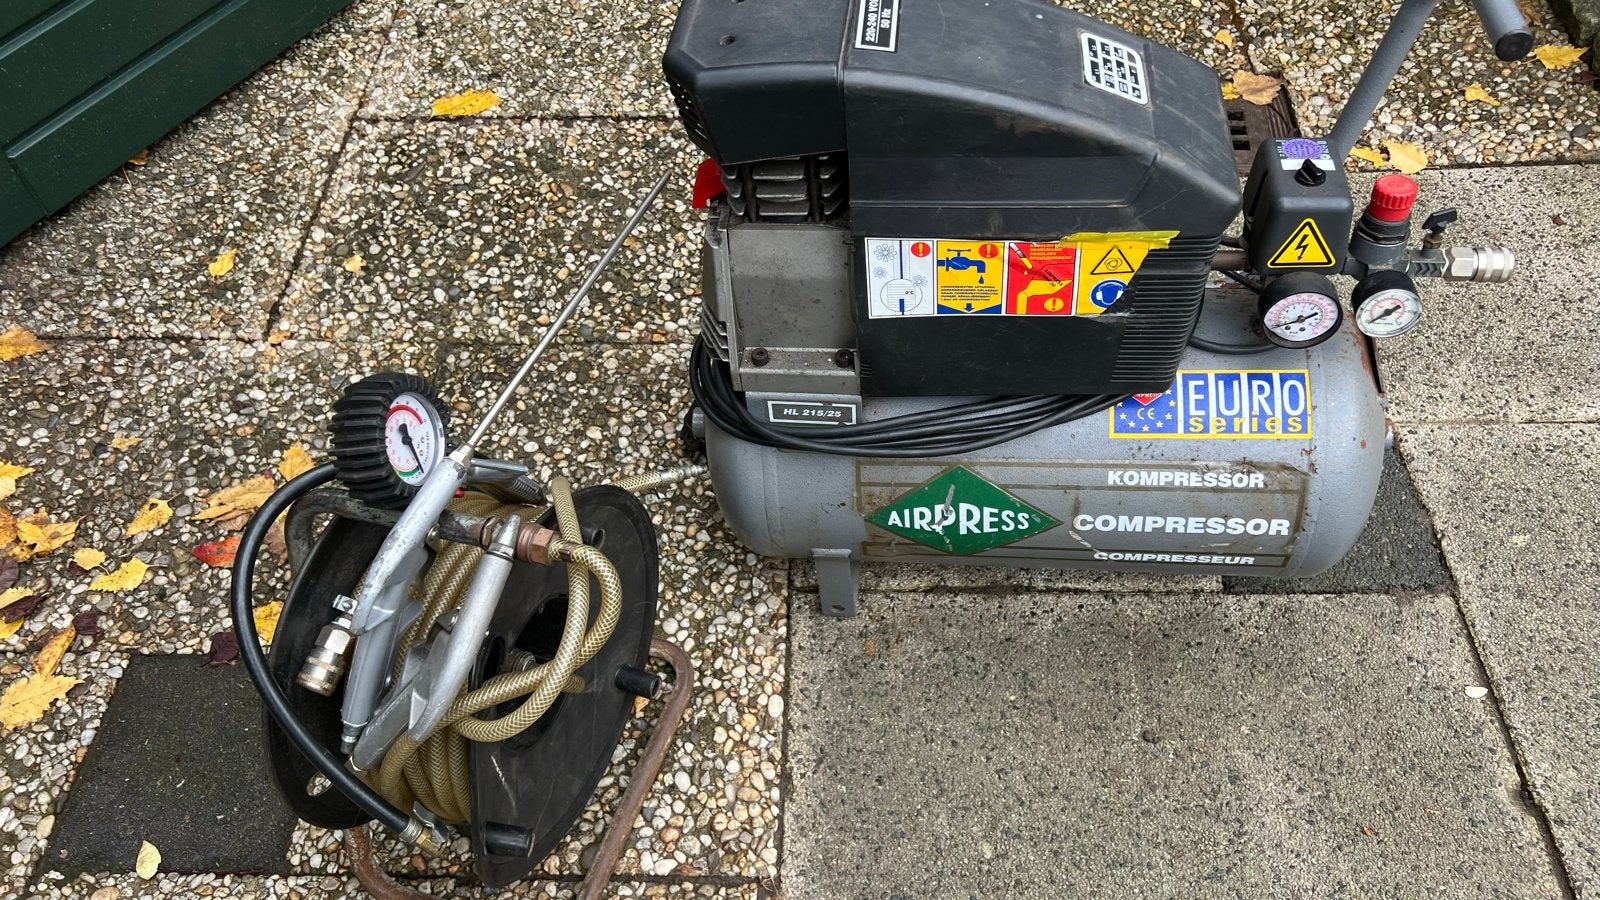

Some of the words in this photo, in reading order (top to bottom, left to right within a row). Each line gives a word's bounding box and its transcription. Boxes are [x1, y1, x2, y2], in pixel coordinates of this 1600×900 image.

[881, 8, 891, 18] Hz
[865, 12, 878, 42] 220-240
[880, 18, 890, 29] 50
[1188, 379, 1305, 416] EURO
[783, 408, 799, 416] HL
[802, 409, 842, 417] 215/25
[1189, 410, 1303, 432] series
[1107, 470, 1264, 489] KOMPRESSOR
[887, 502, 1030, 535] AIRPRESS
[1073, 514, 1290, 536] COMPRESSOR
[1094, 552, 1255, 566] COMPRESSEUR
